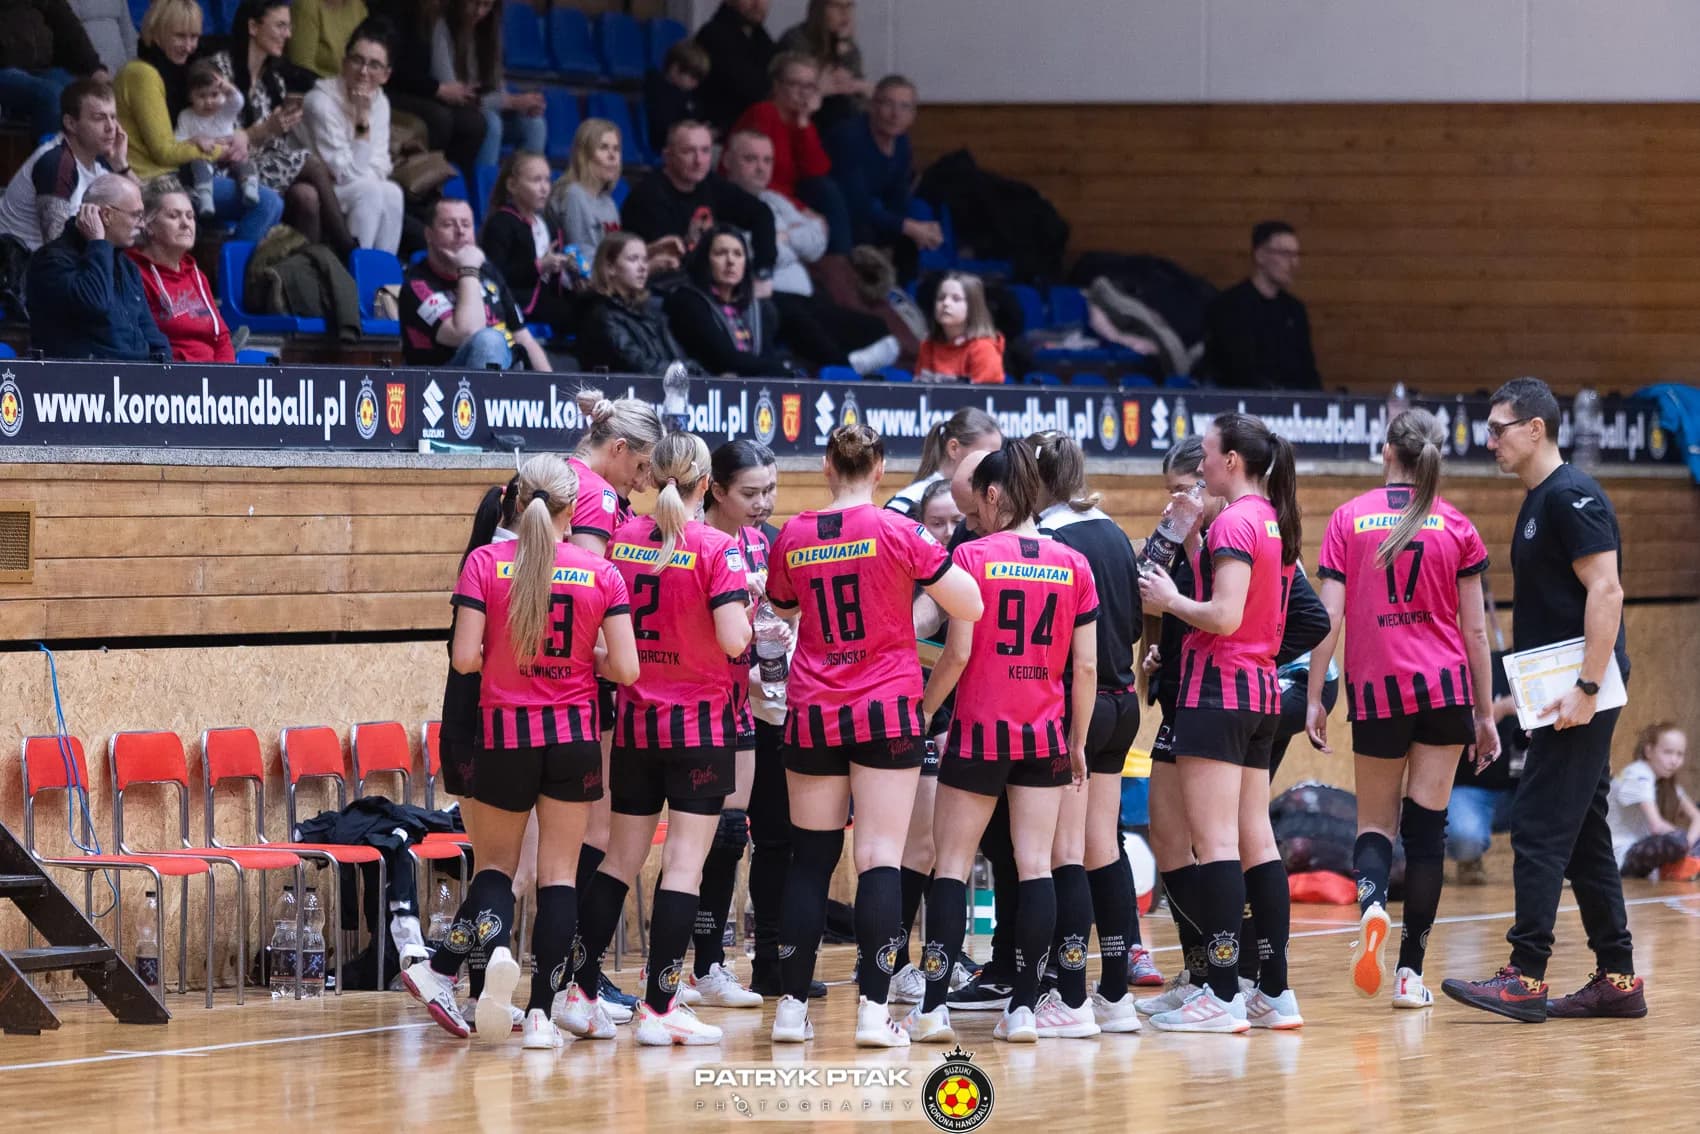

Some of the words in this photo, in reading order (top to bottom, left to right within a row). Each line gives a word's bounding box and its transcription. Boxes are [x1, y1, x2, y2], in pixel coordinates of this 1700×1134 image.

[34, 376, 346, 440] www.koronahandball.pl
[866, 395, 1093, 449] www.kohandball.pl
[1376, 516, 1438, 527] LEWAN
[629, 548, 691, 566] LEWIAN
[805, 542, 869, 562] LEWIATAN
[553, 569, 588, 583] ATAN
[1009, 565, 1068, 581] LEWIATAN
[1379, 541, 1424, 604] 17
[810, 574, 866, 644] 18
[997, 589, 1058, 656] 94
[639, 649, 680, 665] ARCZYK
